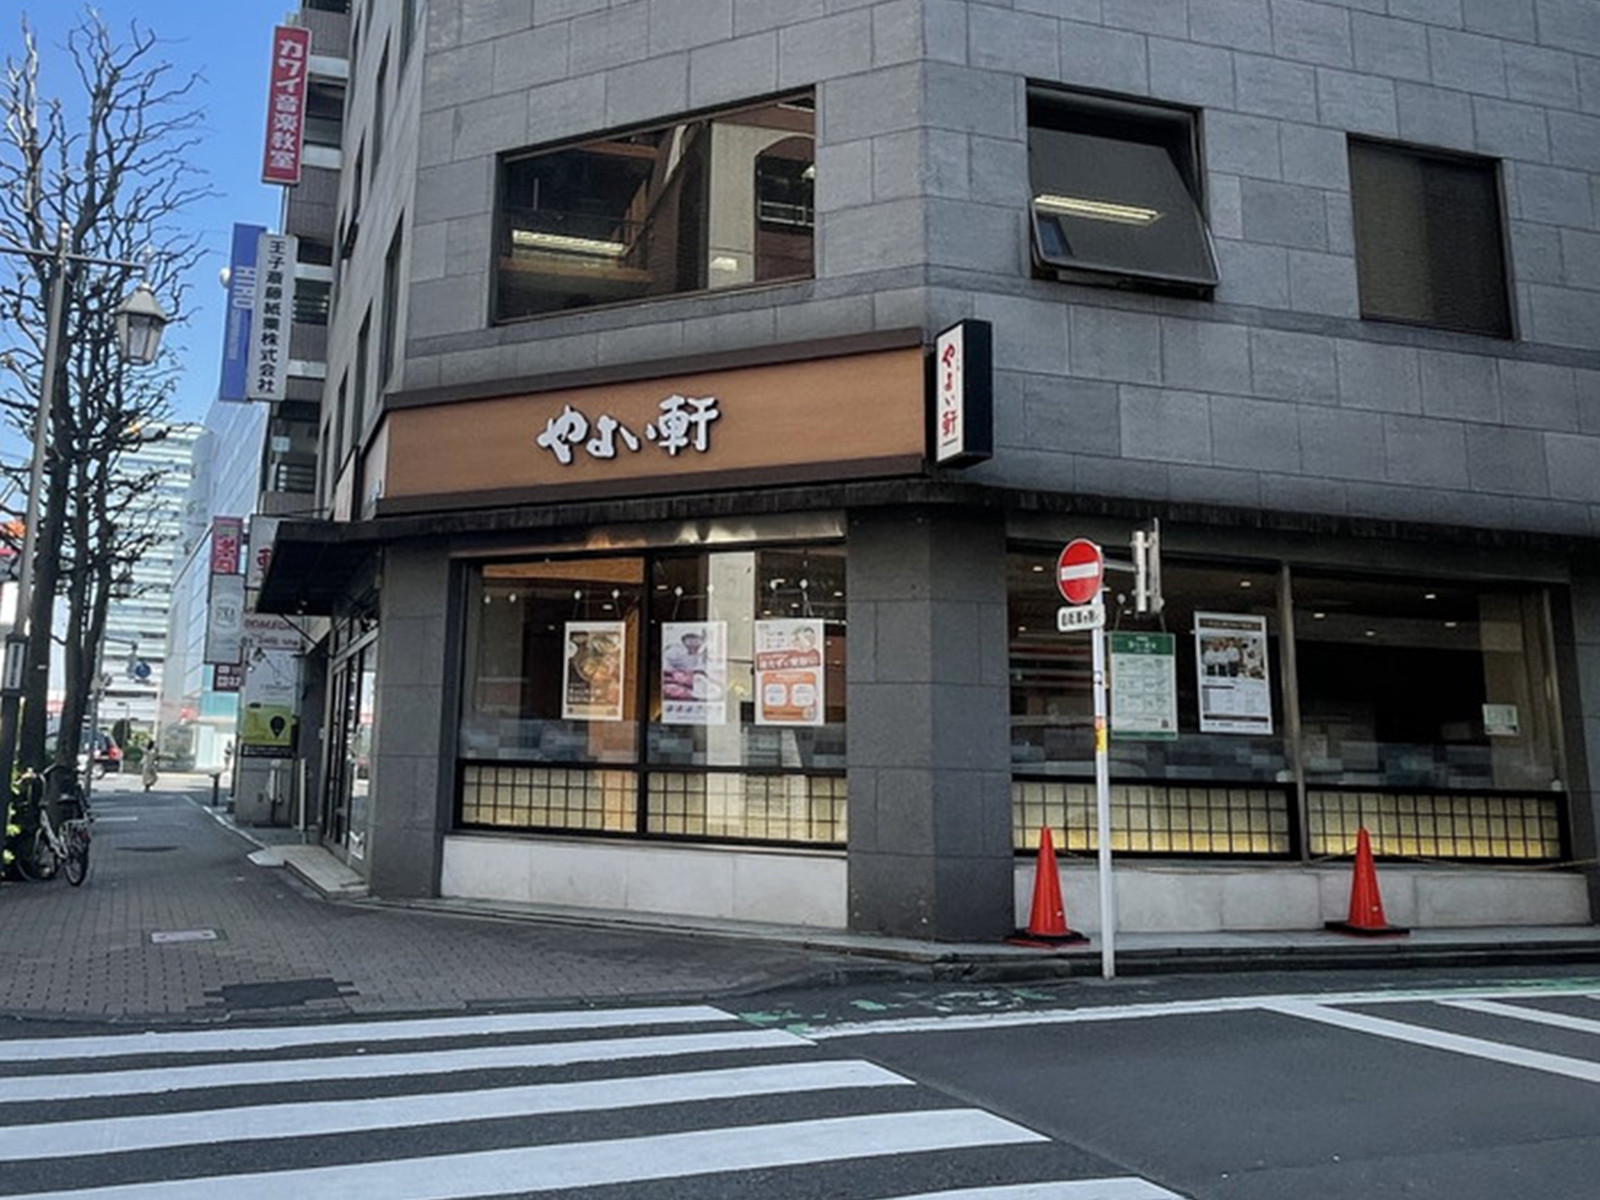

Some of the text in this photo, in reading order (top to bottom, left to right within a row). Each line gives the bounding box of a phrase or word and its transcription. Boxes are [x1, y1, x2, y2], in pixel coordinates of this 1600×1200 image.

[270, 39, 304, 169] カワイ音楽教室
[537, 394, 721, 465] やよい軒
[942, 344, 958, 437] やよい軒
